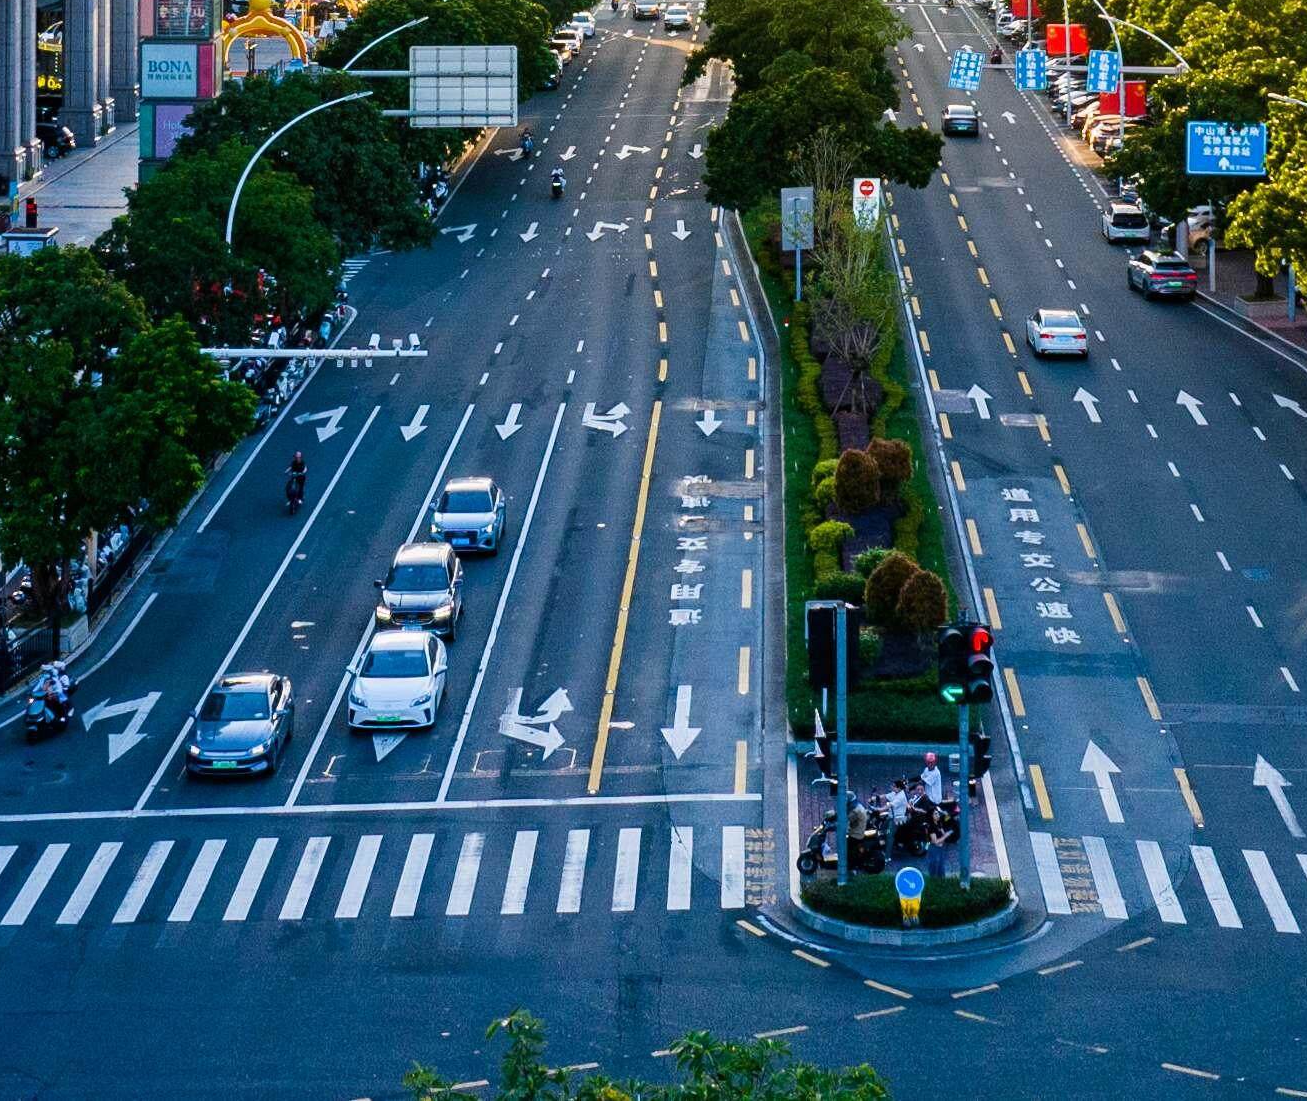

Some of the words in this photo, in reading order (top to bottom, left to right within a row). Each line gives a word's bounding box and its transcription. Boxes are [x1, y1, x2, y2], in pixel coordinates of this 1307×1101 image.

[148, 60, 192, 73] BONA
[1000, 488, 1081, 646] 快速公交专用道
